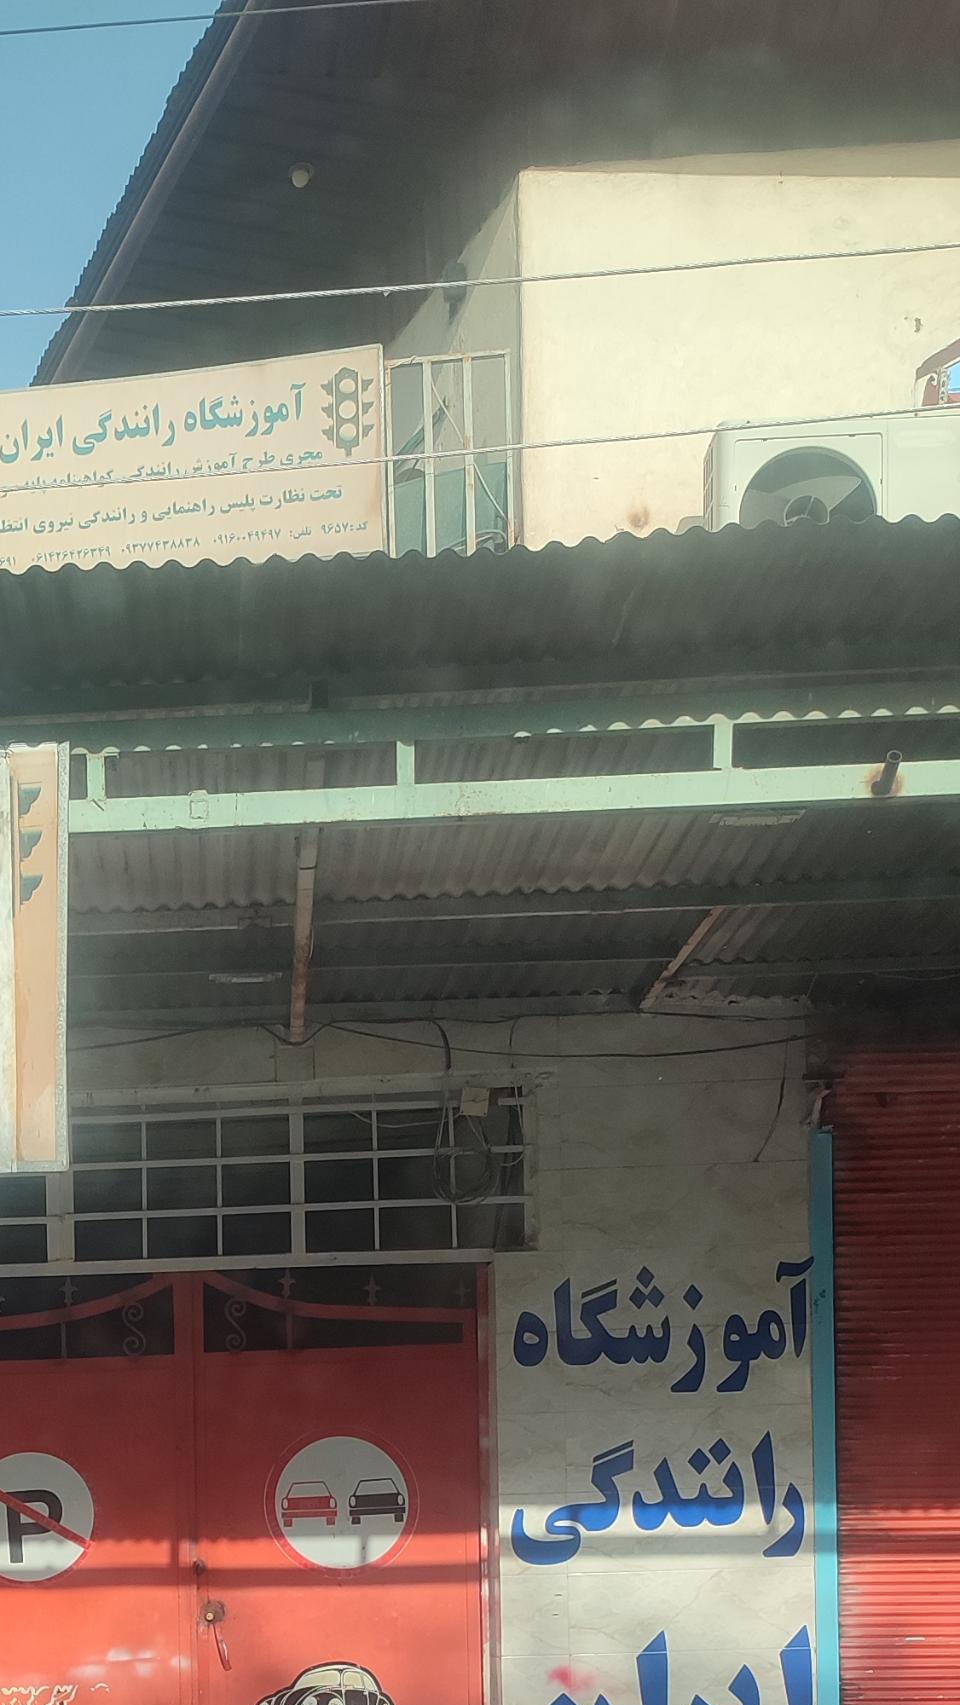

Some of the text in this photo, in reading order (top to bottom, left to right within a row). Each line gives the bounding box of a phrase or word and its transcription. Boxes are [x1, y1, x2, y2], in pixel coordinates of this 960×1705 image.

[0, 382, 306, 464] آموزشگاه رانندگی ایران
[242, 450, 276, 471] طرح
[280, 449, 324, 467] مجری
[220, 494, 255, 514] پلیس
[259, 487, 305, 510] نظارت
[309, 485, 343, 501] تحت
[140, 510, 148, 523] و
[152, 499, 215, 521] راهنمایی
[33, 512, 74, 534] نیروی
[512, 1256, 815, 1393] آموزشگاه
[510, 1431, 806, 1566] رانندگی
